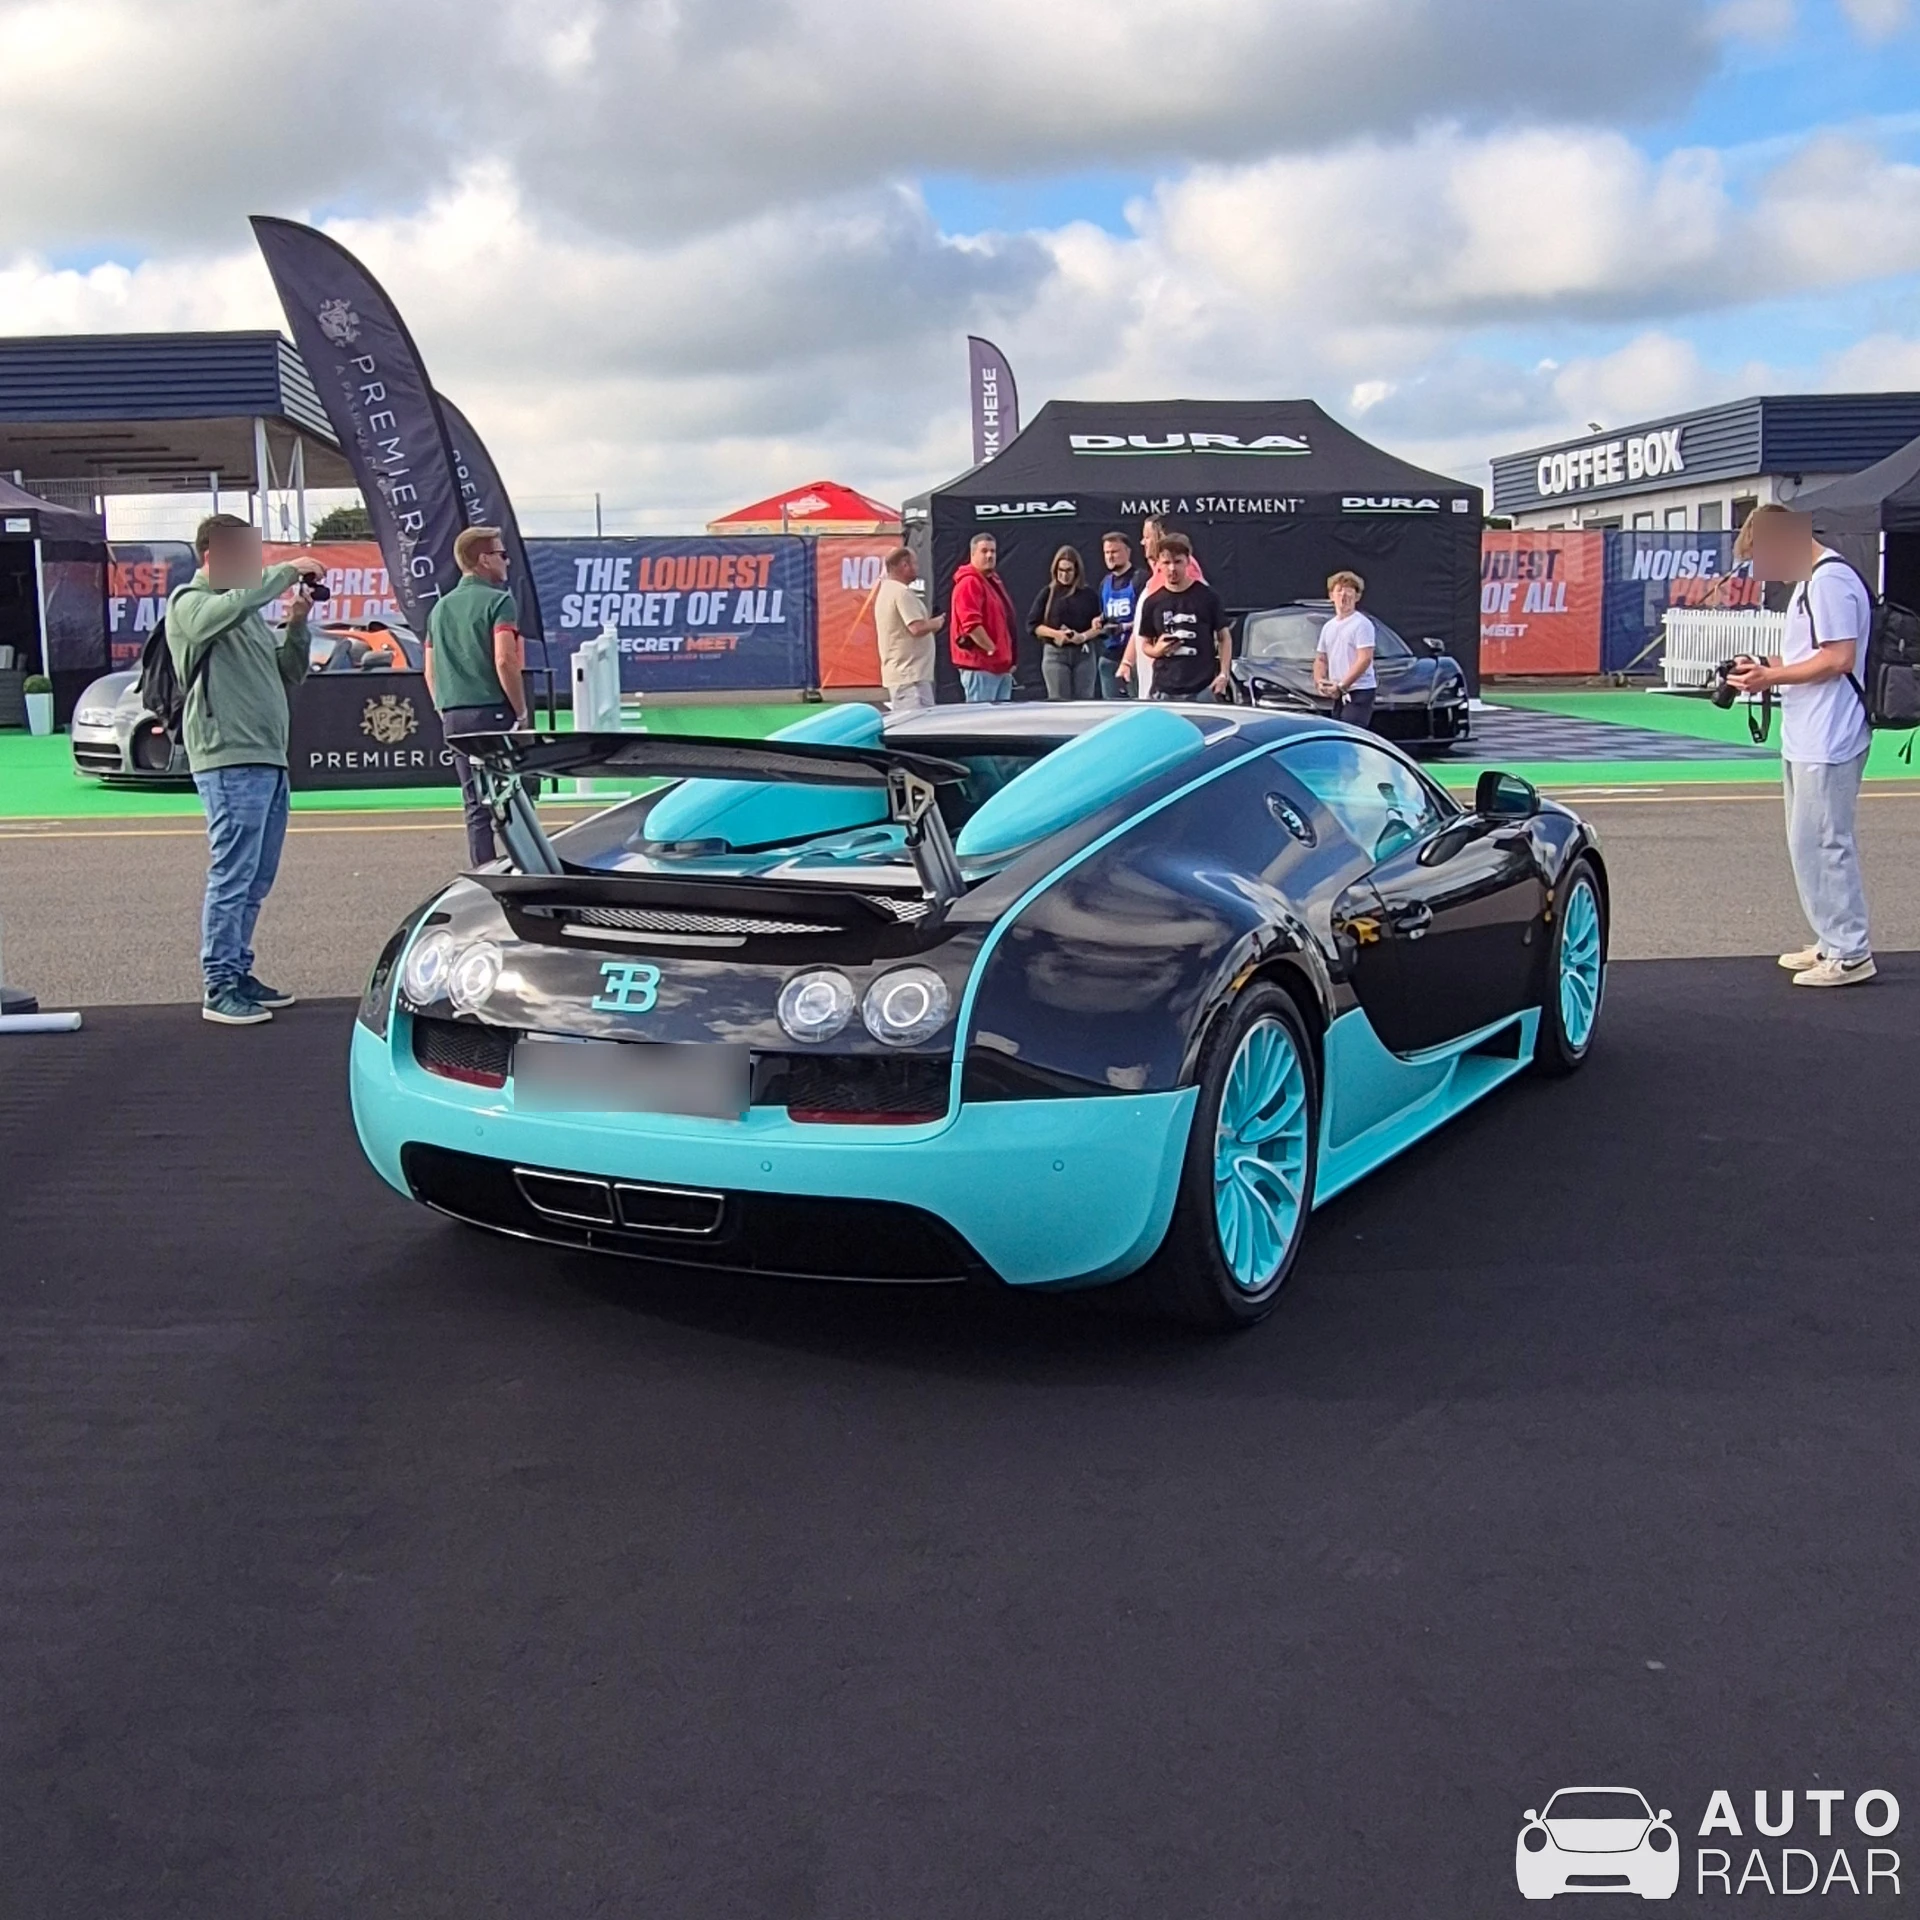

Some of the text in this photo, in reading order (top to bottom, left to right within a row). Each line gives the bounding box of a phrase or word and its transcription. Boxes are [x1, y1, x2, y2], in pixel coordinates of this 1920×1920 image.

[349, 354, 425, 533] PREMIER
[1069, 433, 1310, 449] DURA
[1537, 428, 1685, 497] COFFEE BOX
[974, 500, 1076, 515] DURA
[1120, 497, 1298, 515] MAKE A STATEMENT
[1341, 497, 1440, 509] DURA
[574, 555, 775, 591] THE LOUDEST
[1632, 550, 1720, 580] NOISE.
[560, 590, 786, 628] SECRET OF ALL
[1481, 581, 1568, 613] OF ALL
[684, 635, 739, 652] MEET
[310, 751, 425, 768] PREMIER
